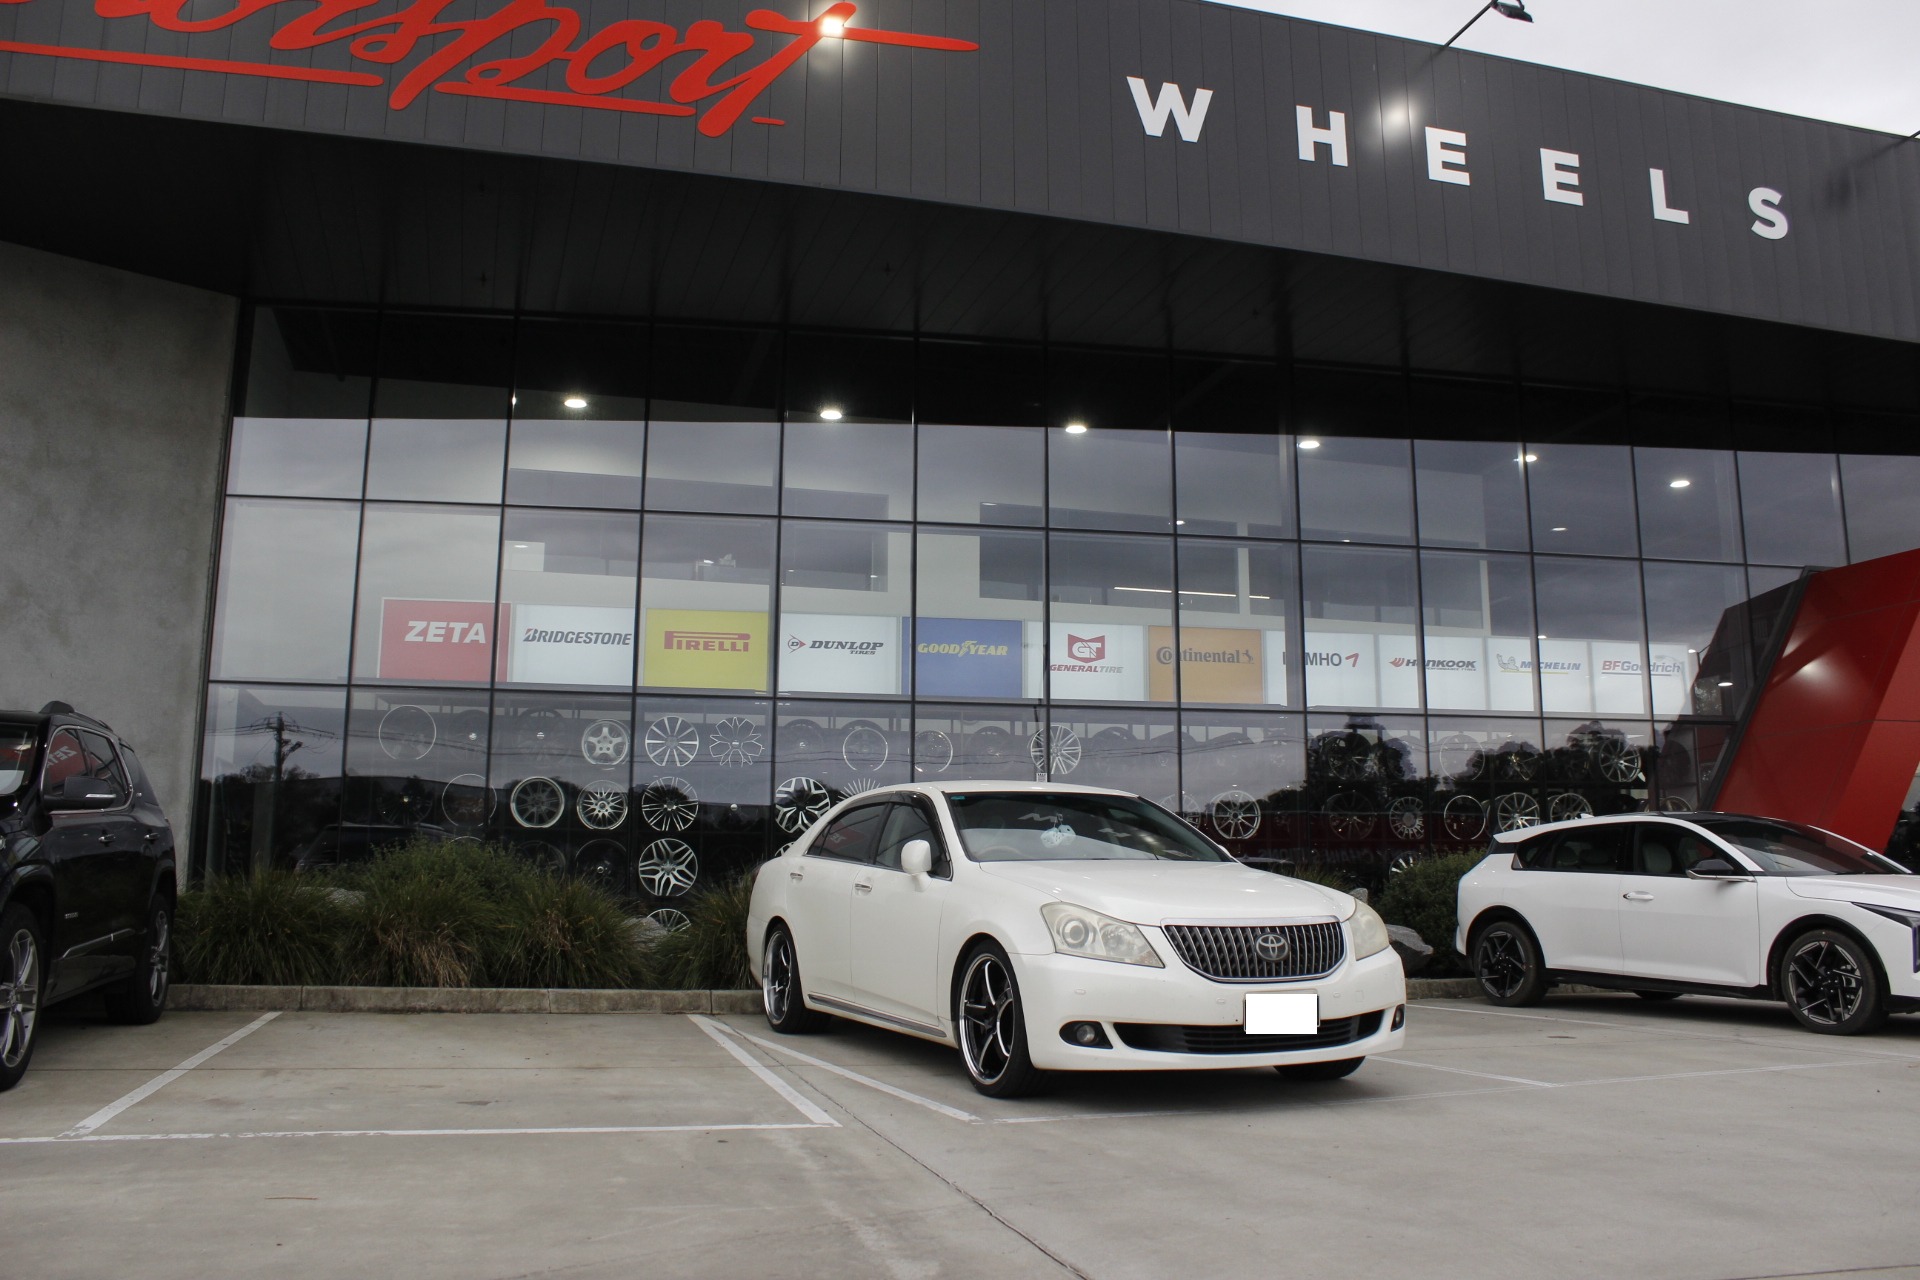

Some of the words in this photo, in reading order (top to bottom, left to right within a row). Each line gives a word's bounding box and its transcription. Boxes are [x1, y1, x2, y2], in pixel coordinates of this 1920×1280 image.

[1126, 76, 1789, 240] WHEELS
[404, 620, 486, 644] ZETA
[523, 628, 632, 646] BRIDGESTONE
[664, 630, 751, 652] PIRELLI
[809, 640, 884, 651] DUNLOP
[918, 640, 1008, 657] GOODYEAR
[1072, 641, 1102, 658] GT
[1282, 651, 1342, 666] MHO
[1405, 659, 1477, 668] HNKOOK
[1520, 660, 1582, 671] MCHELIN
[1601, 660, 1681, 673] BFGodrich
